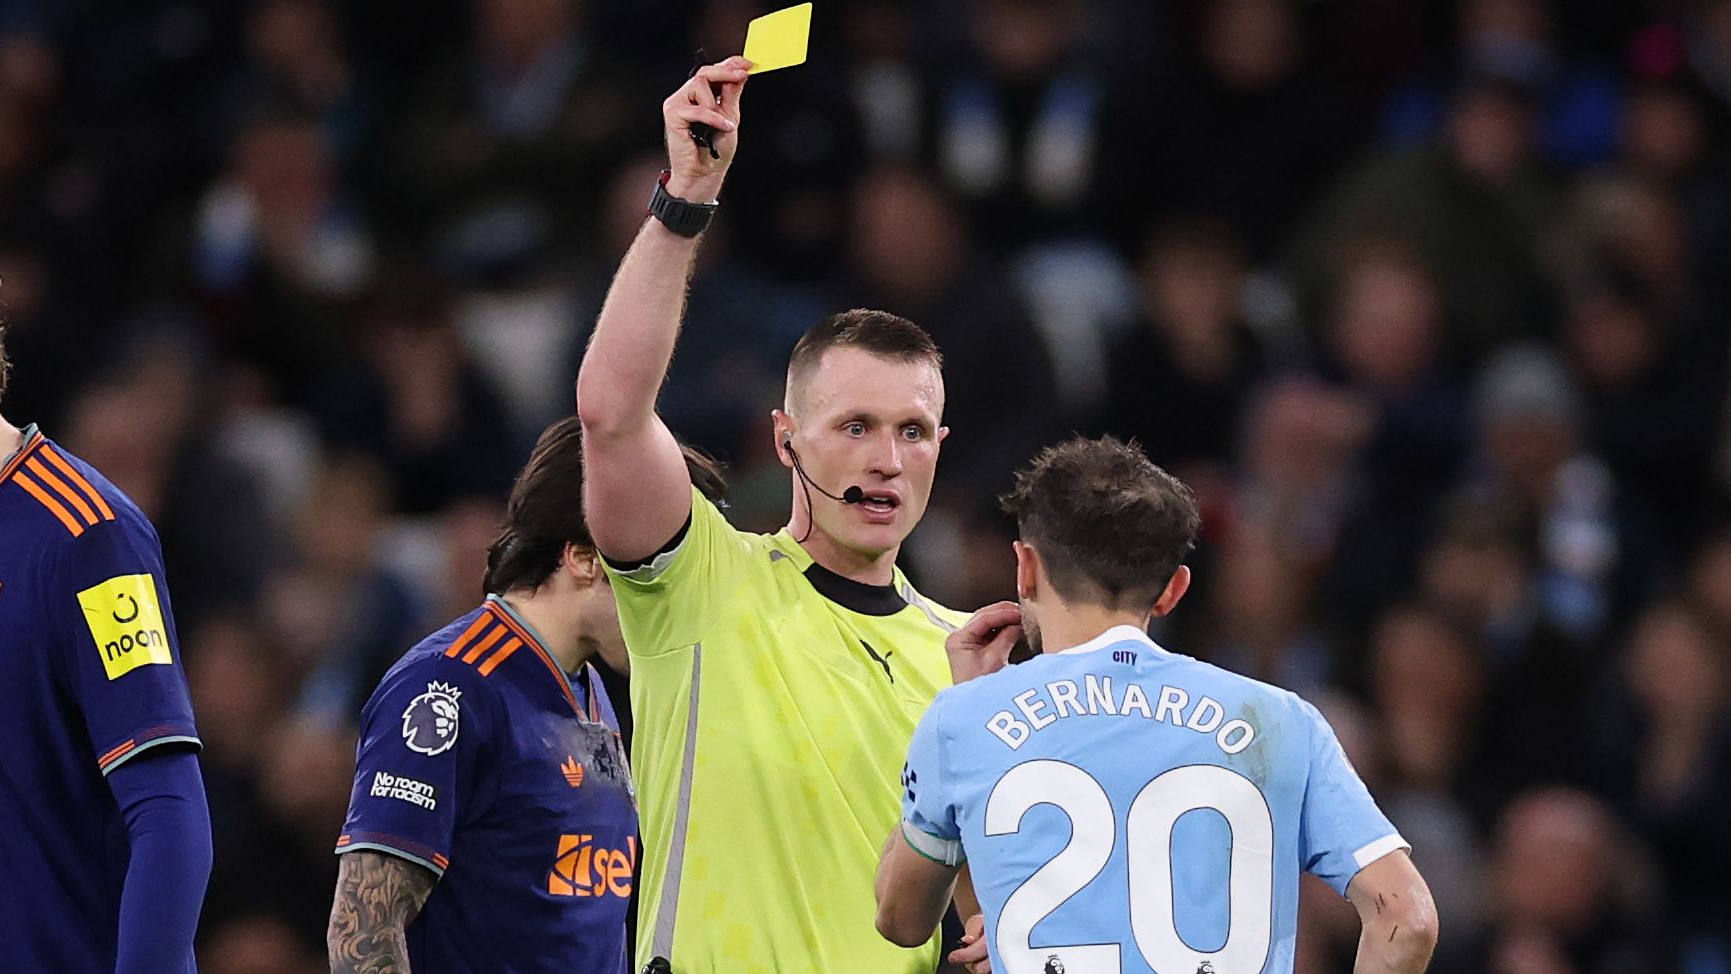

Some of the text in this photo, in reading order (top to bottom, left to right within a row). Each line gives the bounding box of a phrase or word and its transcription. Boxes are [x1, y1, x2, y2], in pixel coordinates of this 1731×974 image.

[105, 629, 163, 662] noon
[1112, 650, 1138, 666] CITY
[984, 673, 1257, 755] BERNARDO
